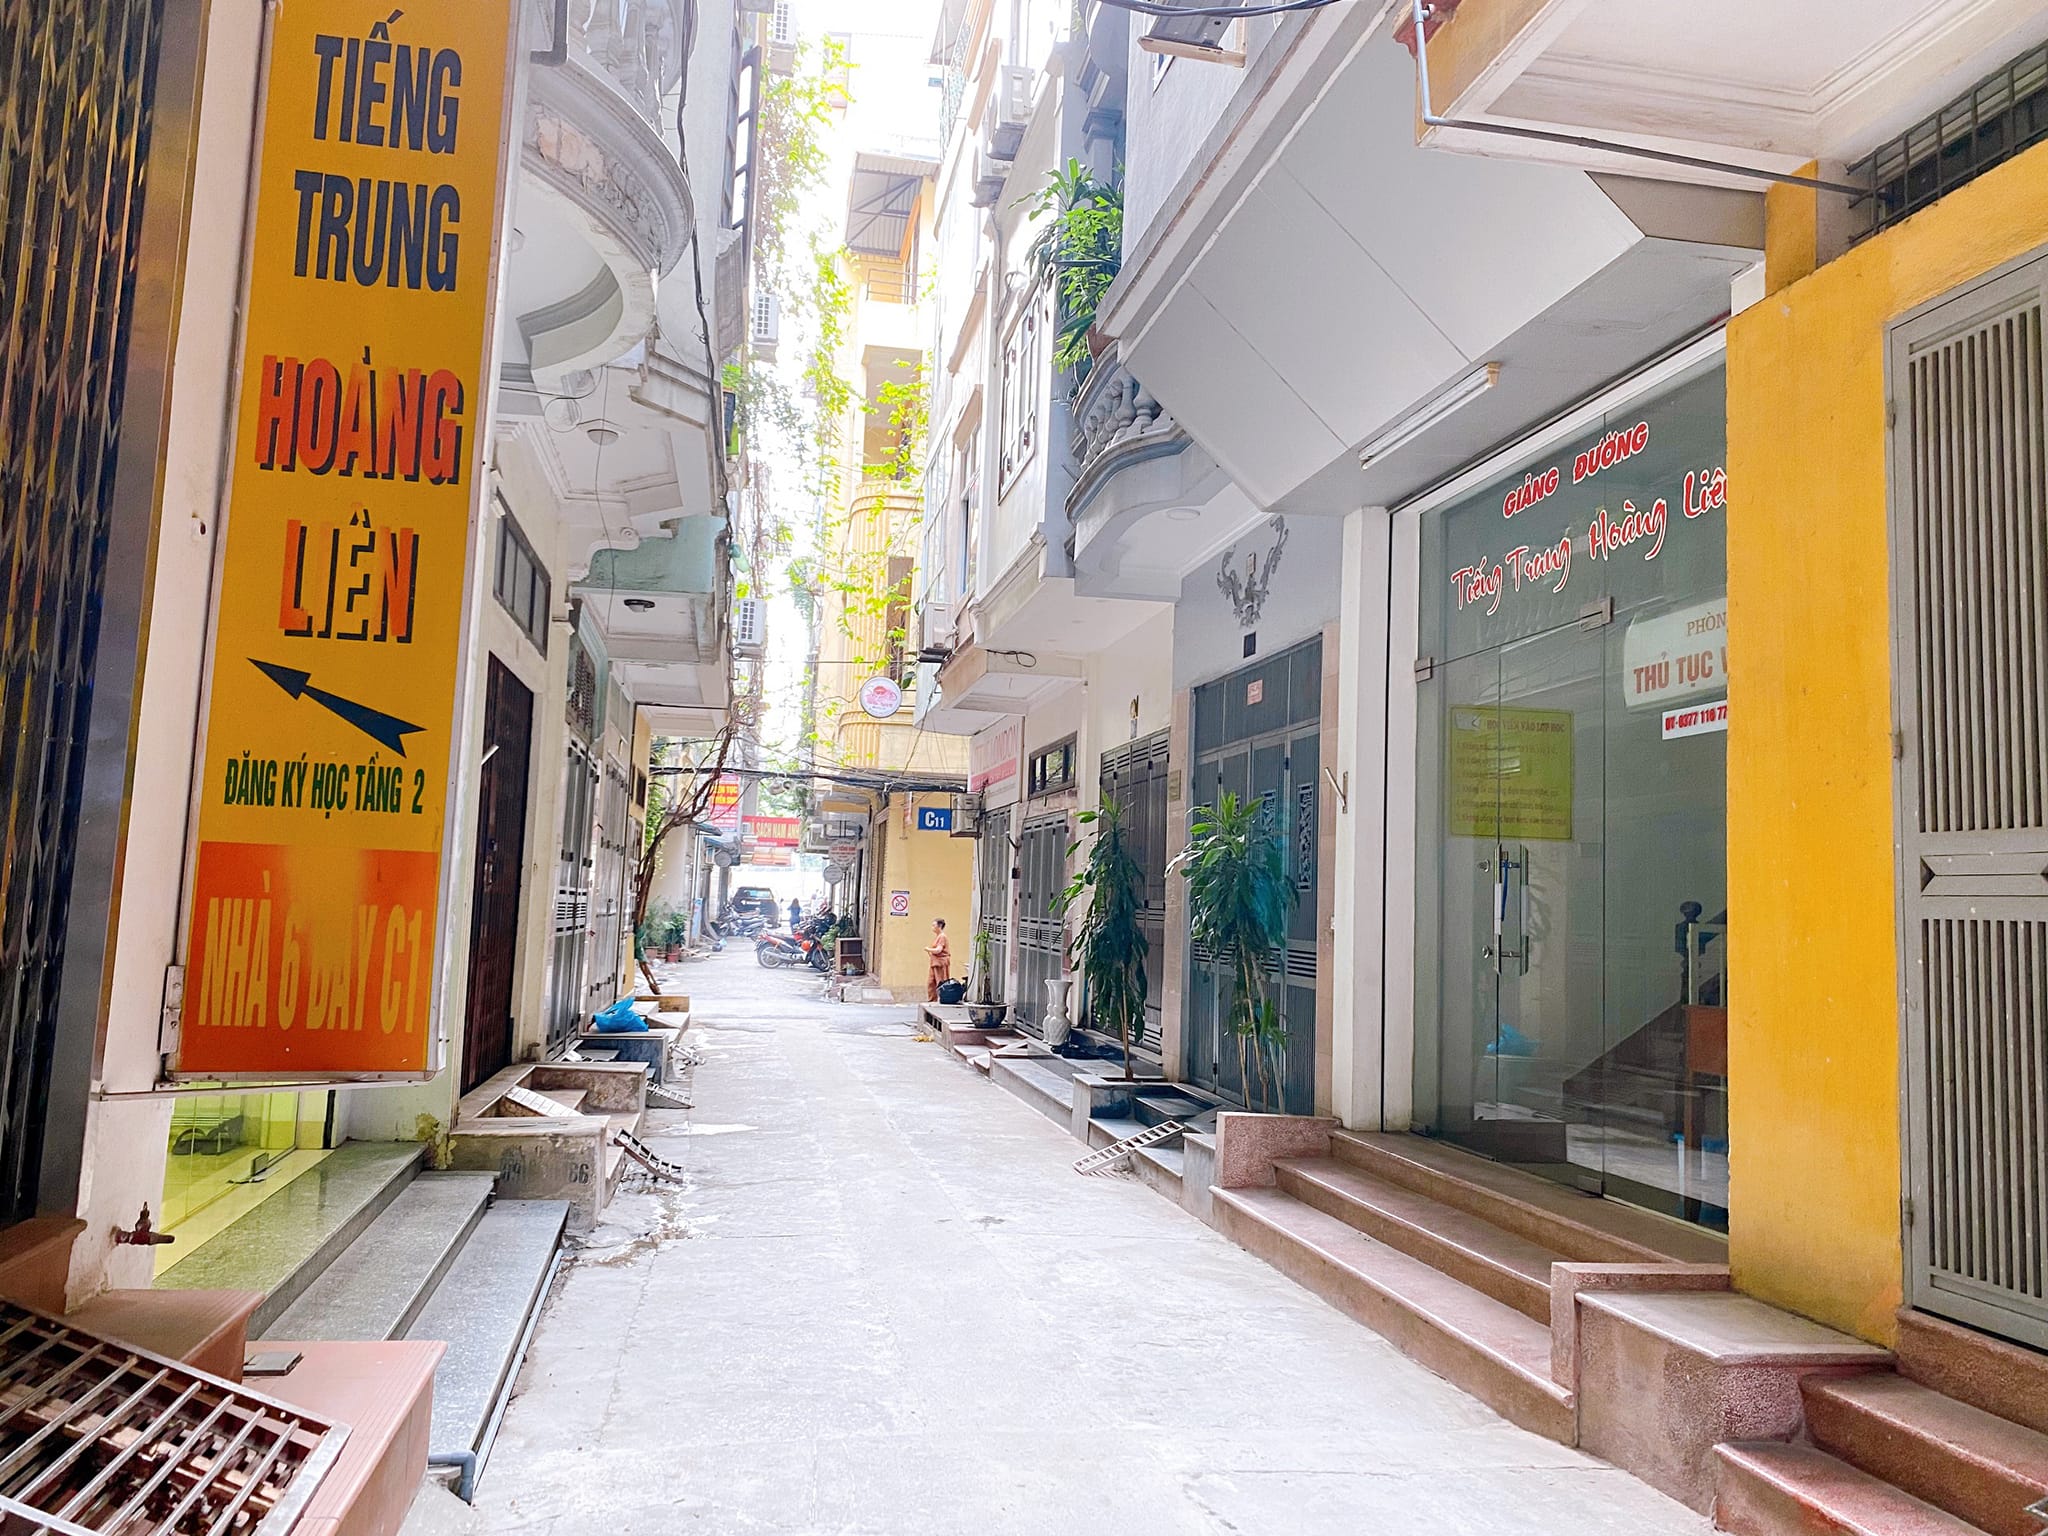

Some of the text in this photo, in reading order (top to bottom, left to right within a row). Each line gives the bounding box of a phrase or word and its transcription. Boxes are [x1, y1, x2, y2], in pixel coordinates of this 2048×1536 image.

[314, 9, 462, 155] TIẾNG
[294, 169, 461, 292] TRUNG
[255, 346, 464, 486] HOÀNG
[1502, 421, 1649, 519] GIẢNG ĐƯỜNG
[278, 502, 419, 643] LIÊN
[1451, 556, 1502, 616] Tiếng
[1588, 498, 1668, 561] Hoàng
[1633, 651, 1669, 694] THỦ
[1676, 650, 1713, 688] TỤC
[1687, 612, 1727, 636] PHÒN
[224, 750, 425, 819] ĐĂNG KÝ HỌC TẦNG 2
[198, 870, 272, 1028] NHÀ
[278, 901, 300, 1031] 6
[380, 903, 422, 1034] C1
